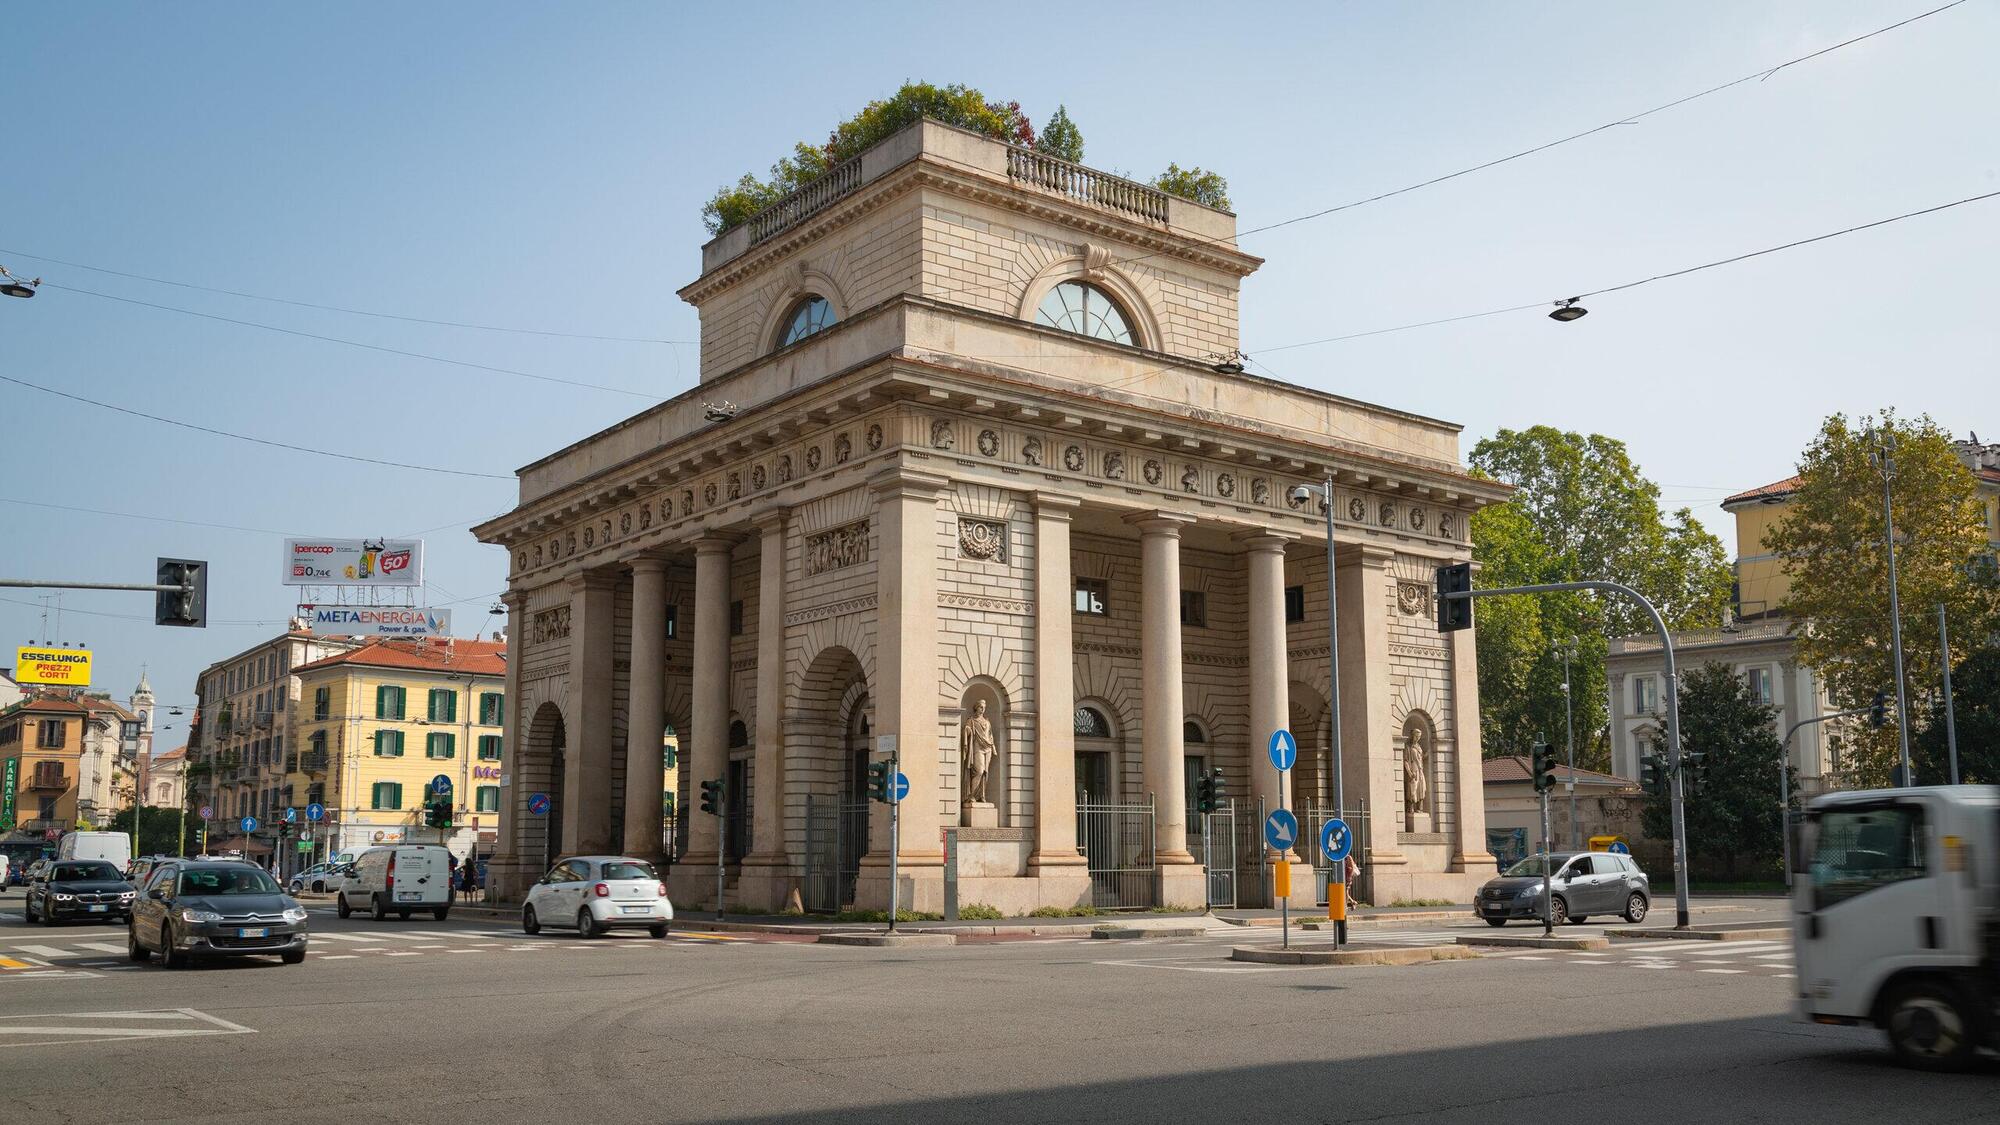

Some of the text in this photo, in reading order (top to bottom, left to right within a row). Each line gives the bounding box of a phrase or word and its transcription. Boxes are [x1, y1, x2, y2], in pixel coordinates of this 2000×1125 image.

[294, 544, 334, 555] ipercoop
[317, 610, 426, 624] METAENERGIA
[378, 625, 402, 633] Power
[403, 625, 410, 633] &
[21, 653, 88, 663] ESSELUNGA
[36, 663, 72, 672] PREZZI
[39, 671, 69, 679] CORTI
[5, 760, 15, 815] FARMACIA
